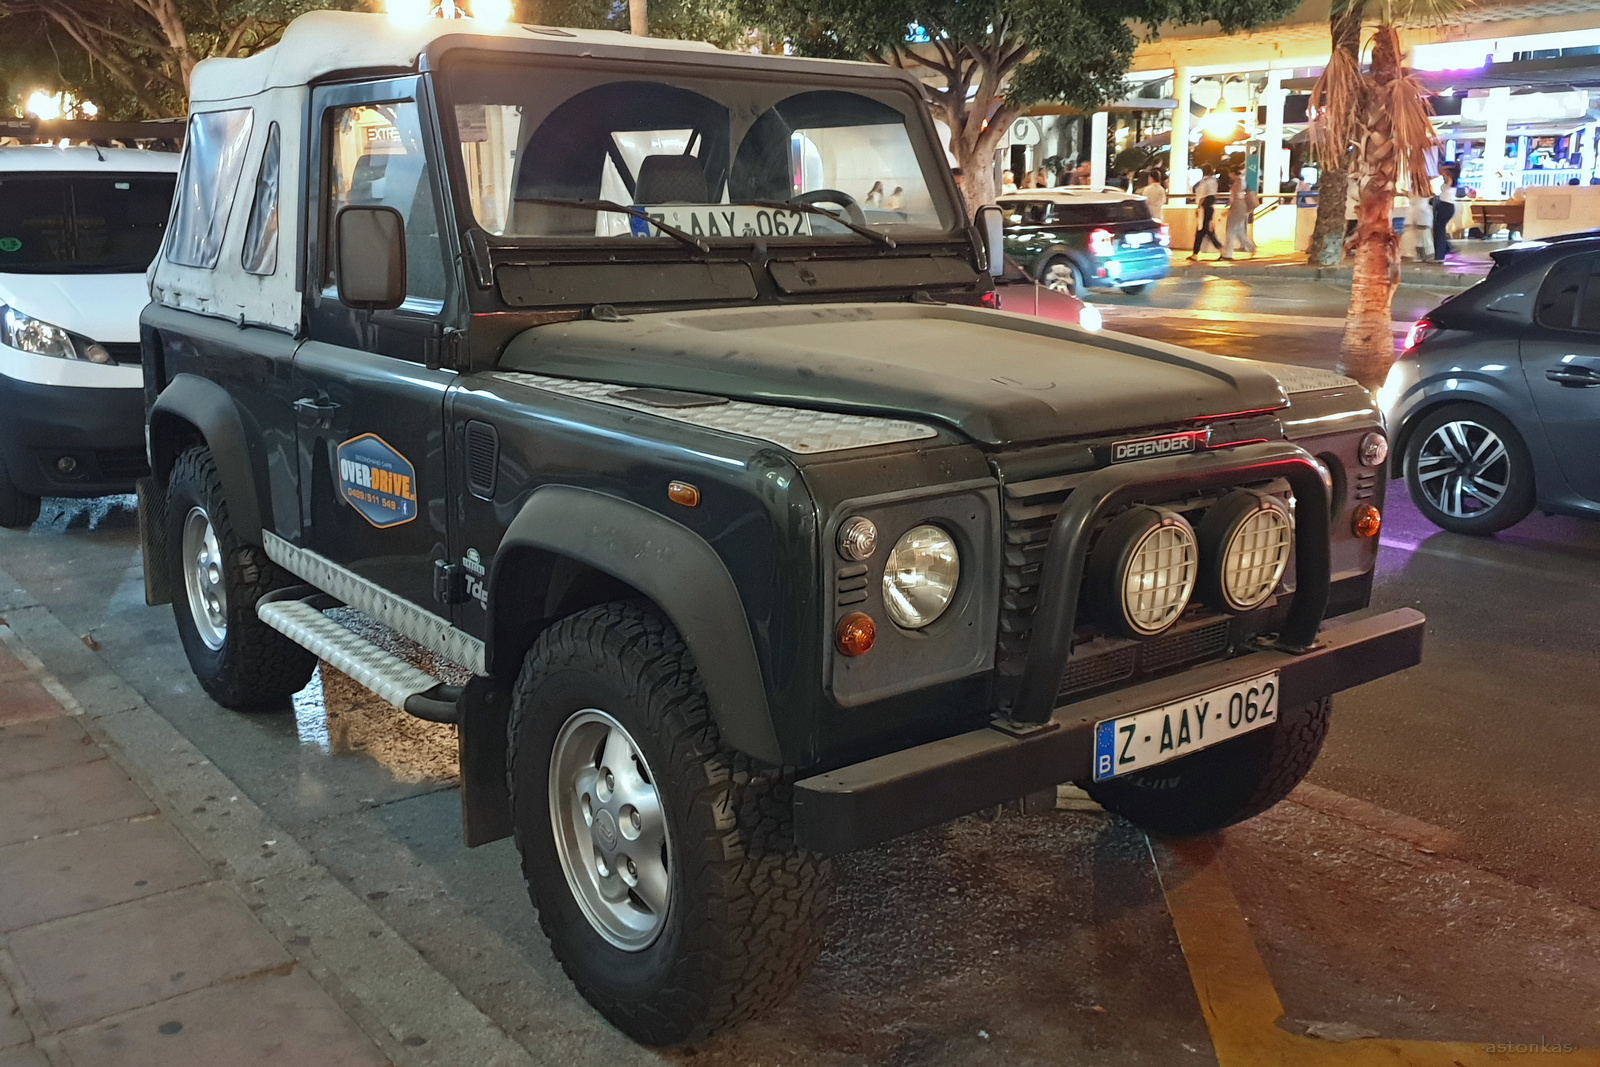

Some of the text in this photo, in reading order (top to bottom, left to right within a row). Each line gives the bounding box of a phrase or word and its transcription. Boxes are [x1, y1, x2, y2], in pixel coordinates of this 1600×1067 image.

[1116, 436, 1189, 459] DEFENDER
[1118, 681, 1276, 766] Z-AAY-062
[1099, 754, 1112, 775] B
